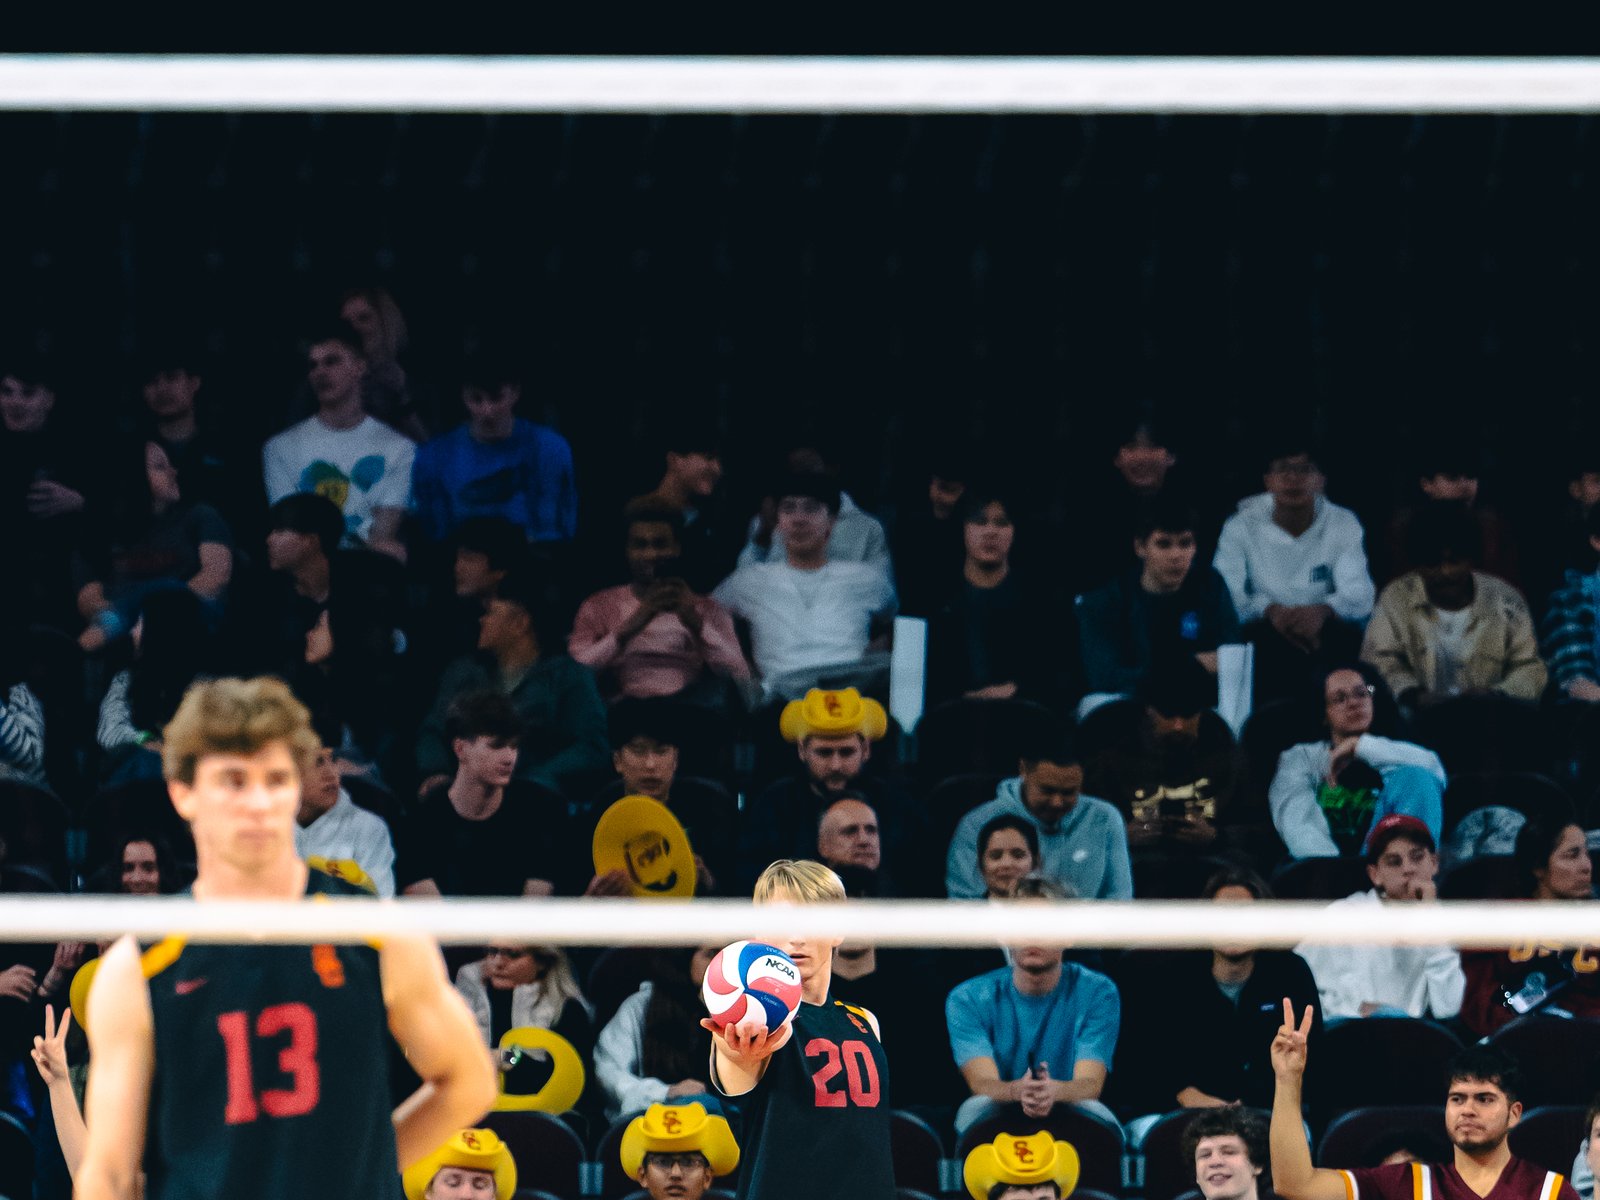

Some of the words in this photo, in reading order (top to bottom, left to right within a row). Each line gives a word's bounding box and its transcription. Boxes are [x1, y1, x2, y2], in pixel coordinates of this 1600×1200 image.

[765, 957, 795, 980] NCAA
[216, 1001, 321, 1125] 13
[804, 1037, 881, 1108] 20
[662, 1110, 682, 1136] SC
[1014, 1140, 1035, 1164] SC
